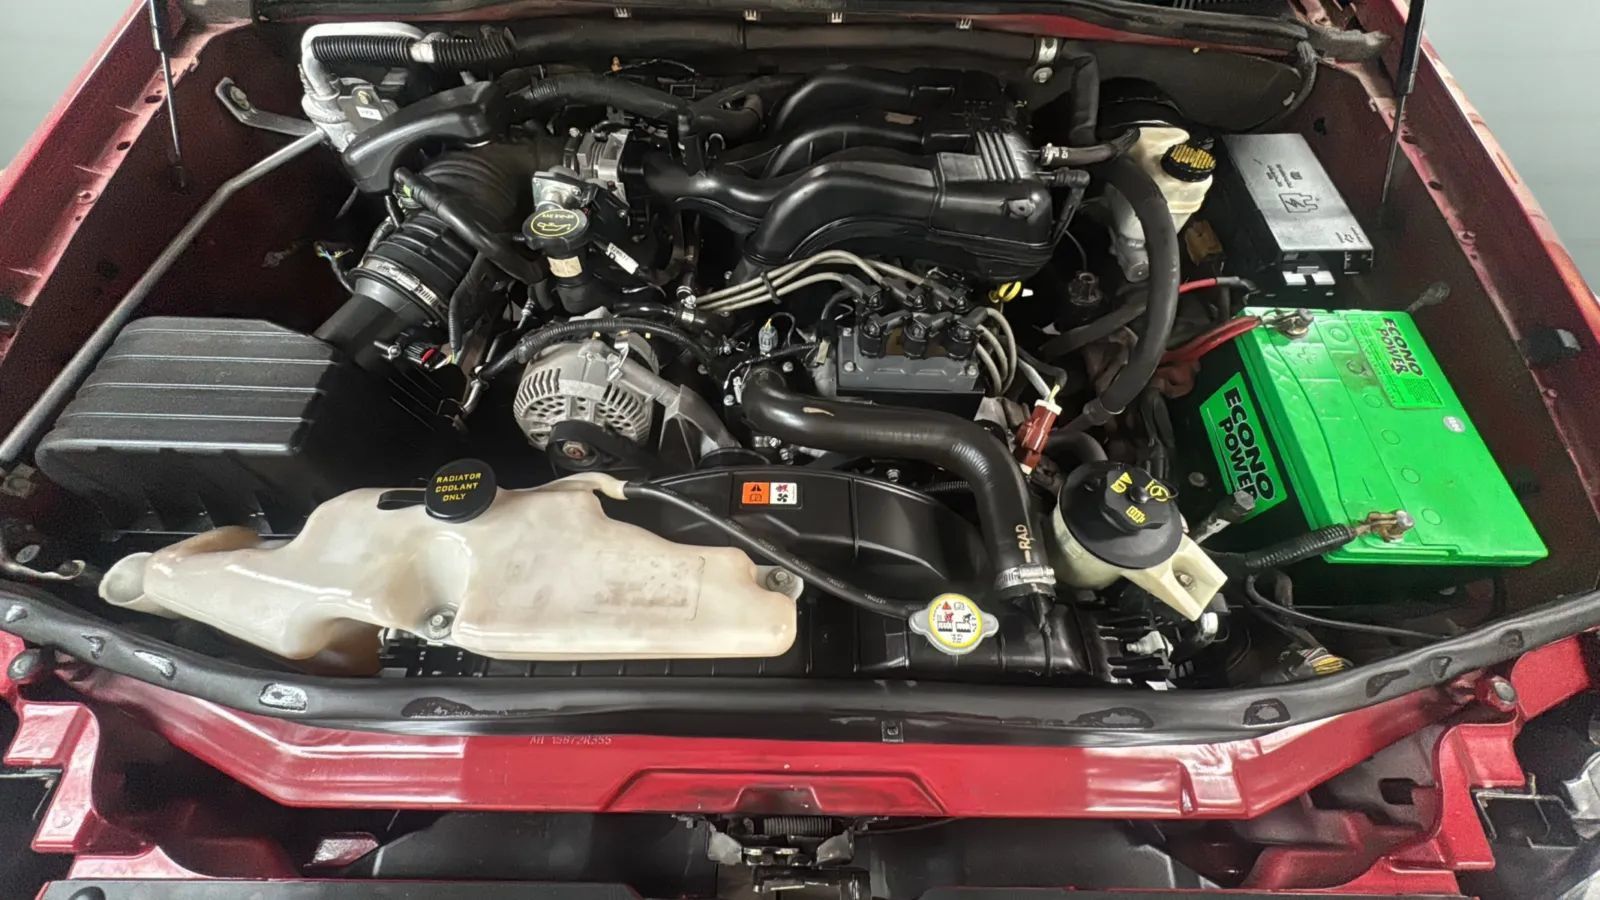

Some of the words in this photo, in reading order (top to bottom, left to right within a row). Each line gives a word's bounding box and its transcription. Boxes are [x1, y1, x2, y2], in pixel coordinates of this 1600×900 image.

[1376, 329, 1409, 375] POWER
[1382, 317, 1423, 376] ECONO
[1223, 387, 1275, 500] ECONO
[435, 482, 479, 493] COOLANT
[436, 472, 482, 483] RADIATOR
[442, 493, 466, 502] ONLY
[1015, 524, 1032, 550] RAD
